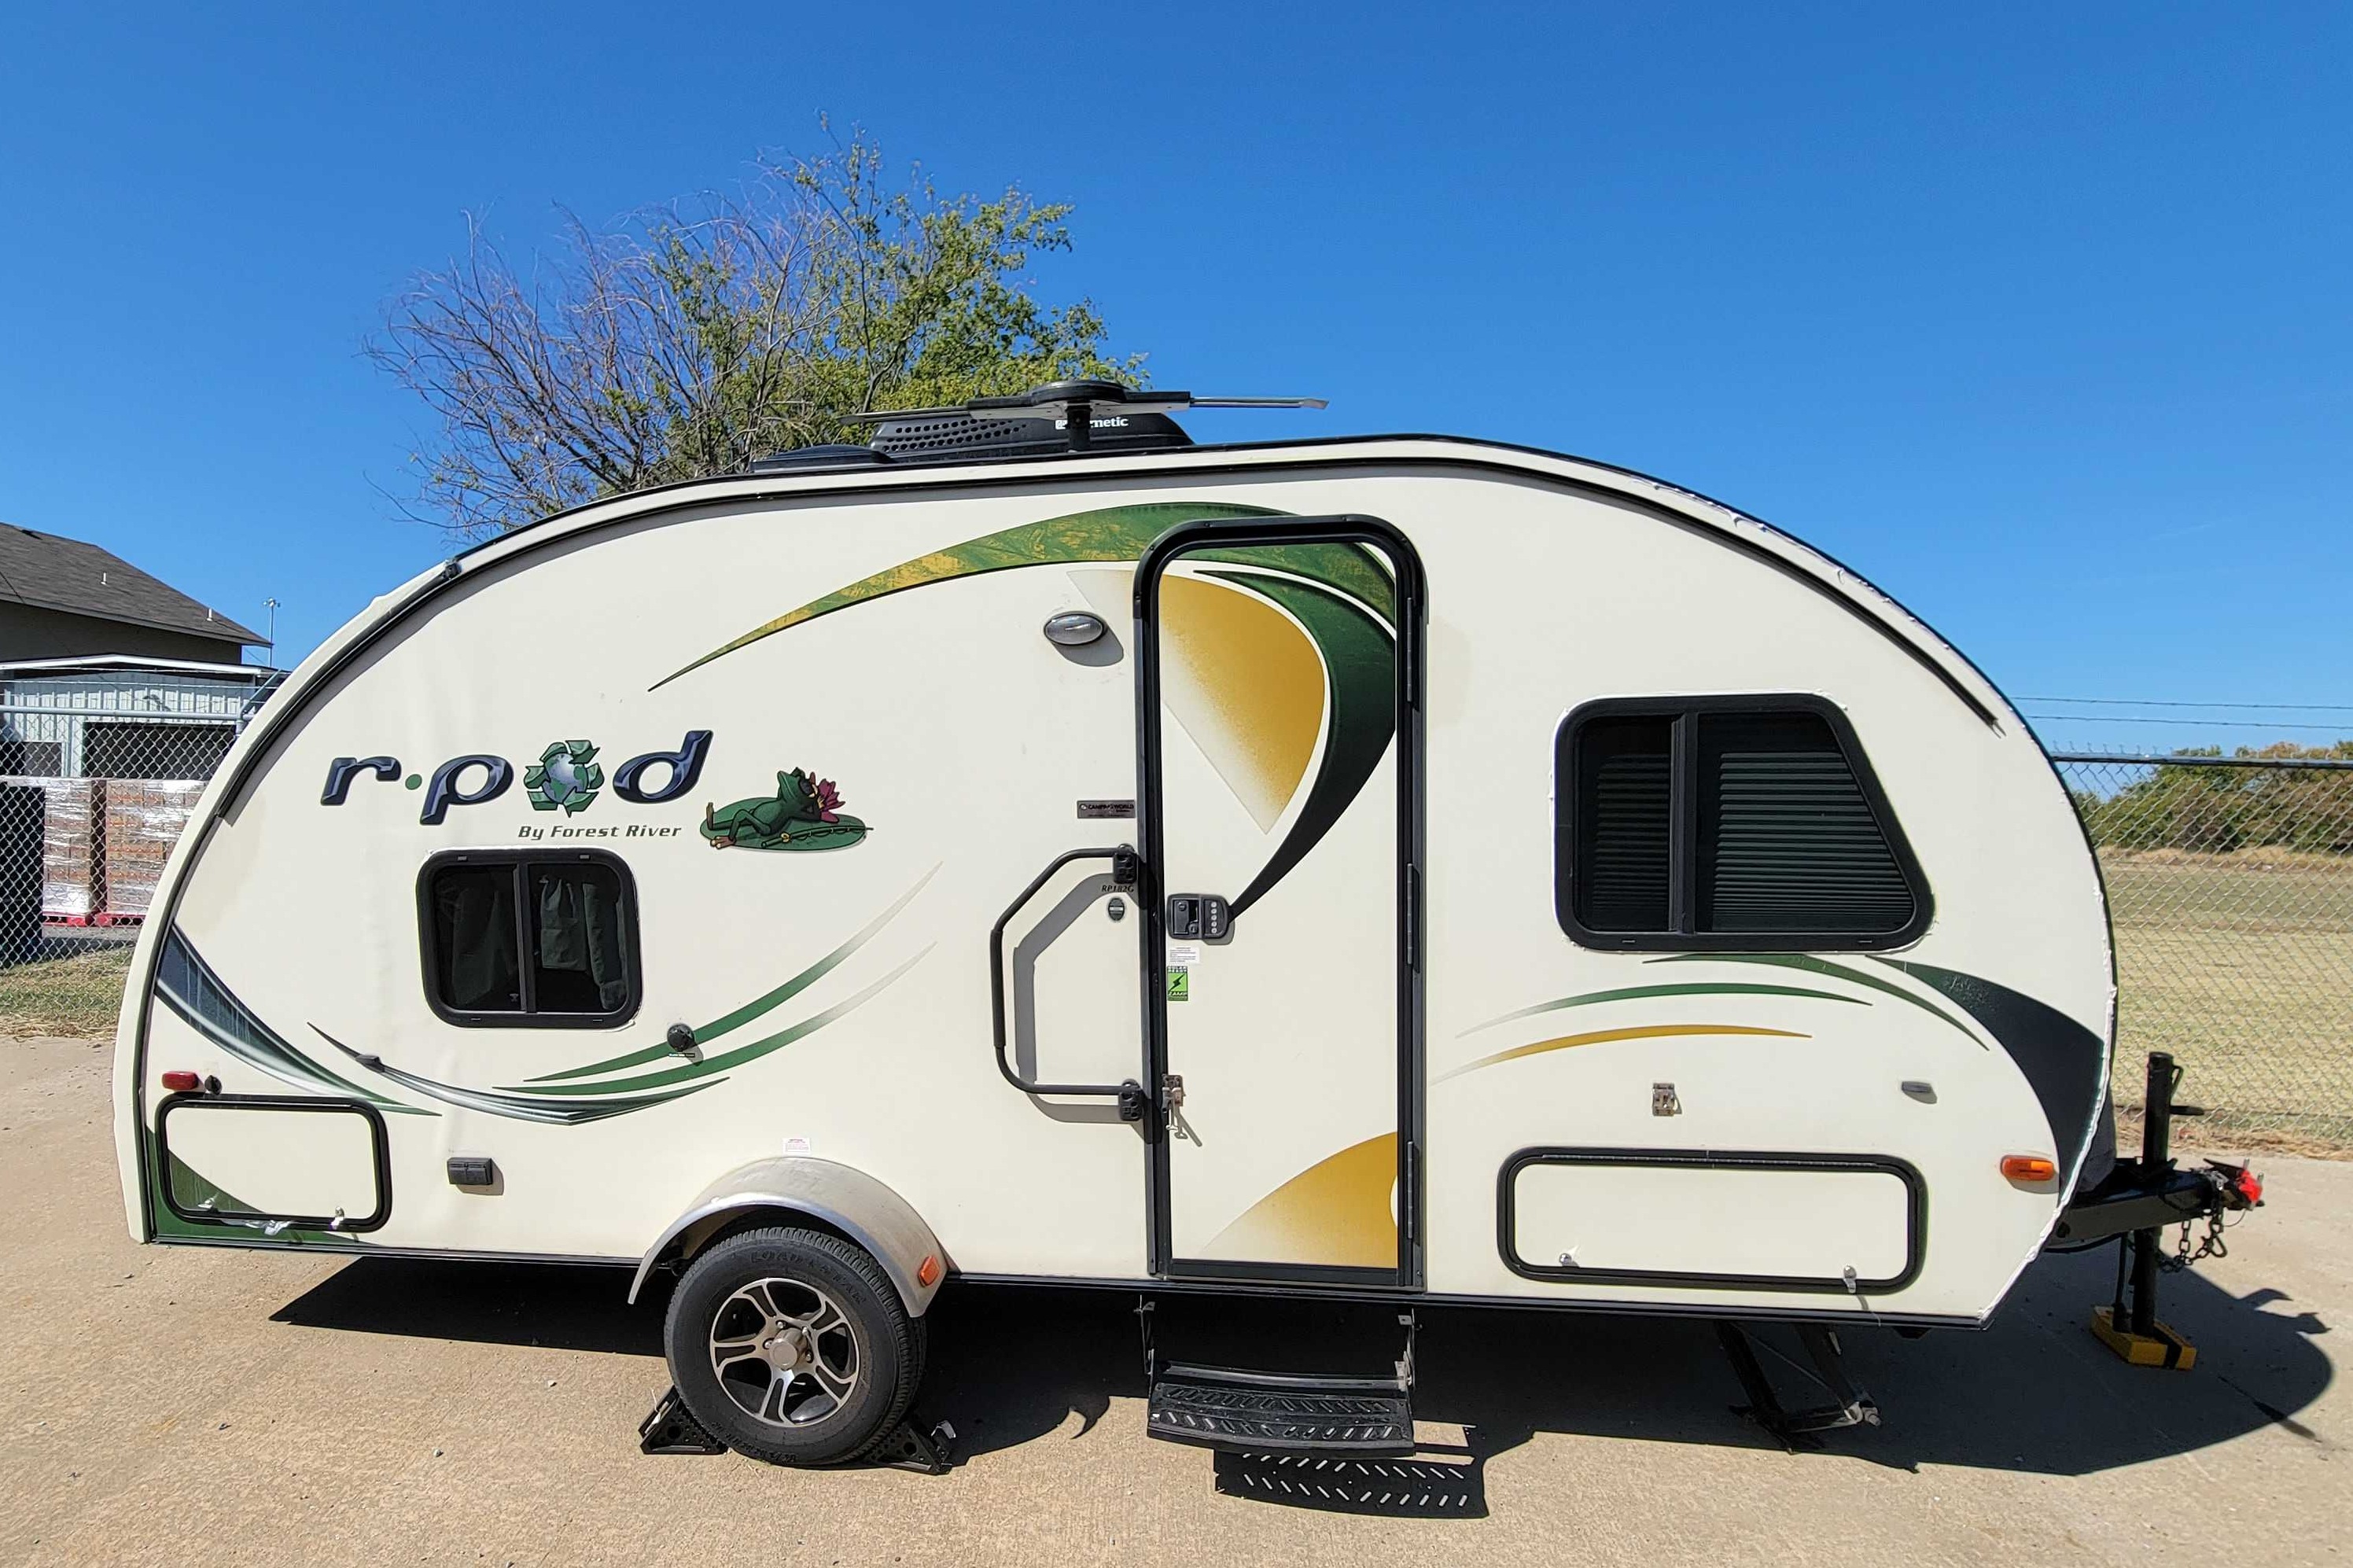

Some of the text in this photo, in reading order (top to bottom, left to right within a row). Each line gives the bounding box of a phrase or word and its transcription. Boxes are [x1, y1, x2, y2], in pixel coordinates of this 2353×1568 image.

[1089, 417, 1129, 428] metic
[517, 824, 682, 841] By Forest River
